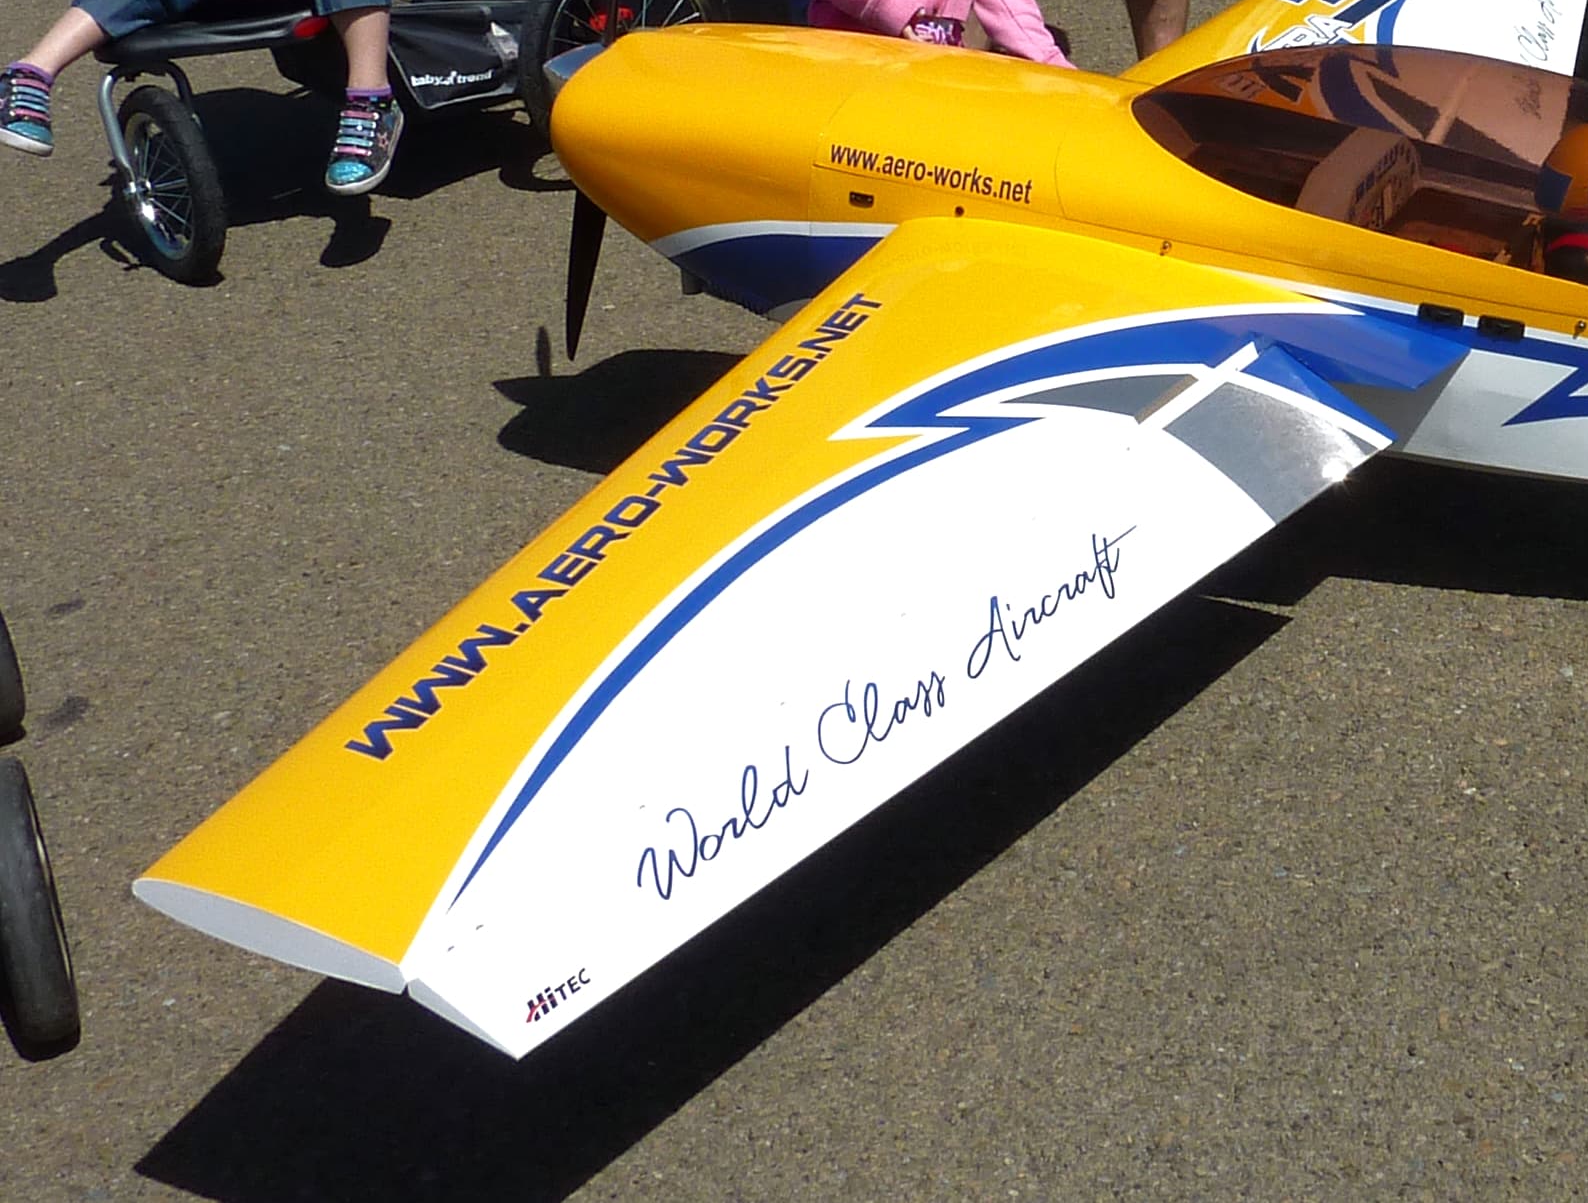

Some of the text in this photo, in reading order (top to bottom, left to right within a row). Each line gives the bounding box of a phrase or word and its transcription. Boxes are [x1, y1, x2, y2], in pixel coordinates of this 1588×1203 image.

[830, 143, 1032, 204] www.aero-works.net
[345, 293, 882, 761] WWW.AERO-WORKS.NET
[637, 525, 1137, 899] World Class Aircraft
